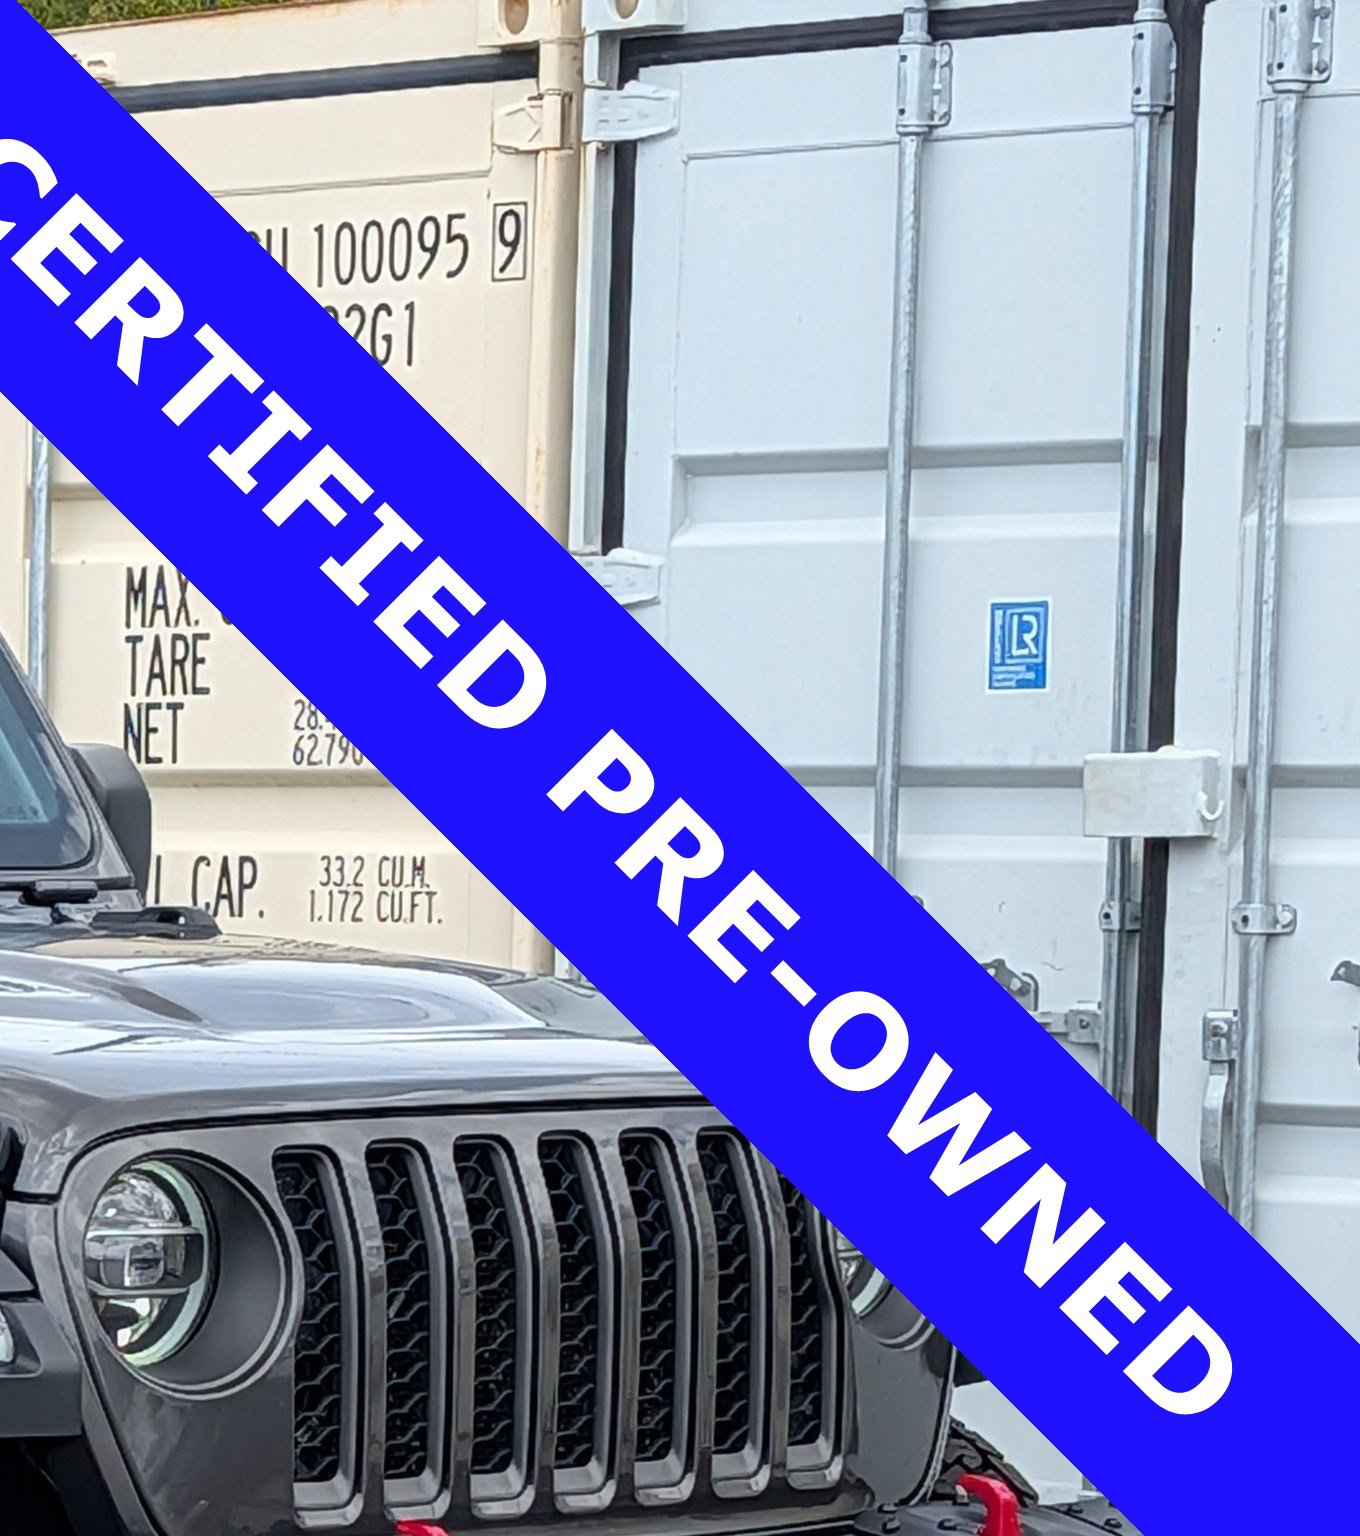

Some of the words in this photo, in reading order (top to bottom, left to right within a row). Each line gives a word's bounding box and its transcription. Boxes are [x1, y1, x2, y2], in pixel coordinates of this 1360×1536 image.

[313, 212, 469, 288] 100095
[497, 208, 522, 274] 9
[322, 300, 415, 367] 2G1
[124, 632, 211, 697] TARE
[1011, 614, 1038, 656] LR
[123, 702, 185, 764] NET
[319, 855, 365, 887] 33.2
[309, 889, 364, 922] 1.172
